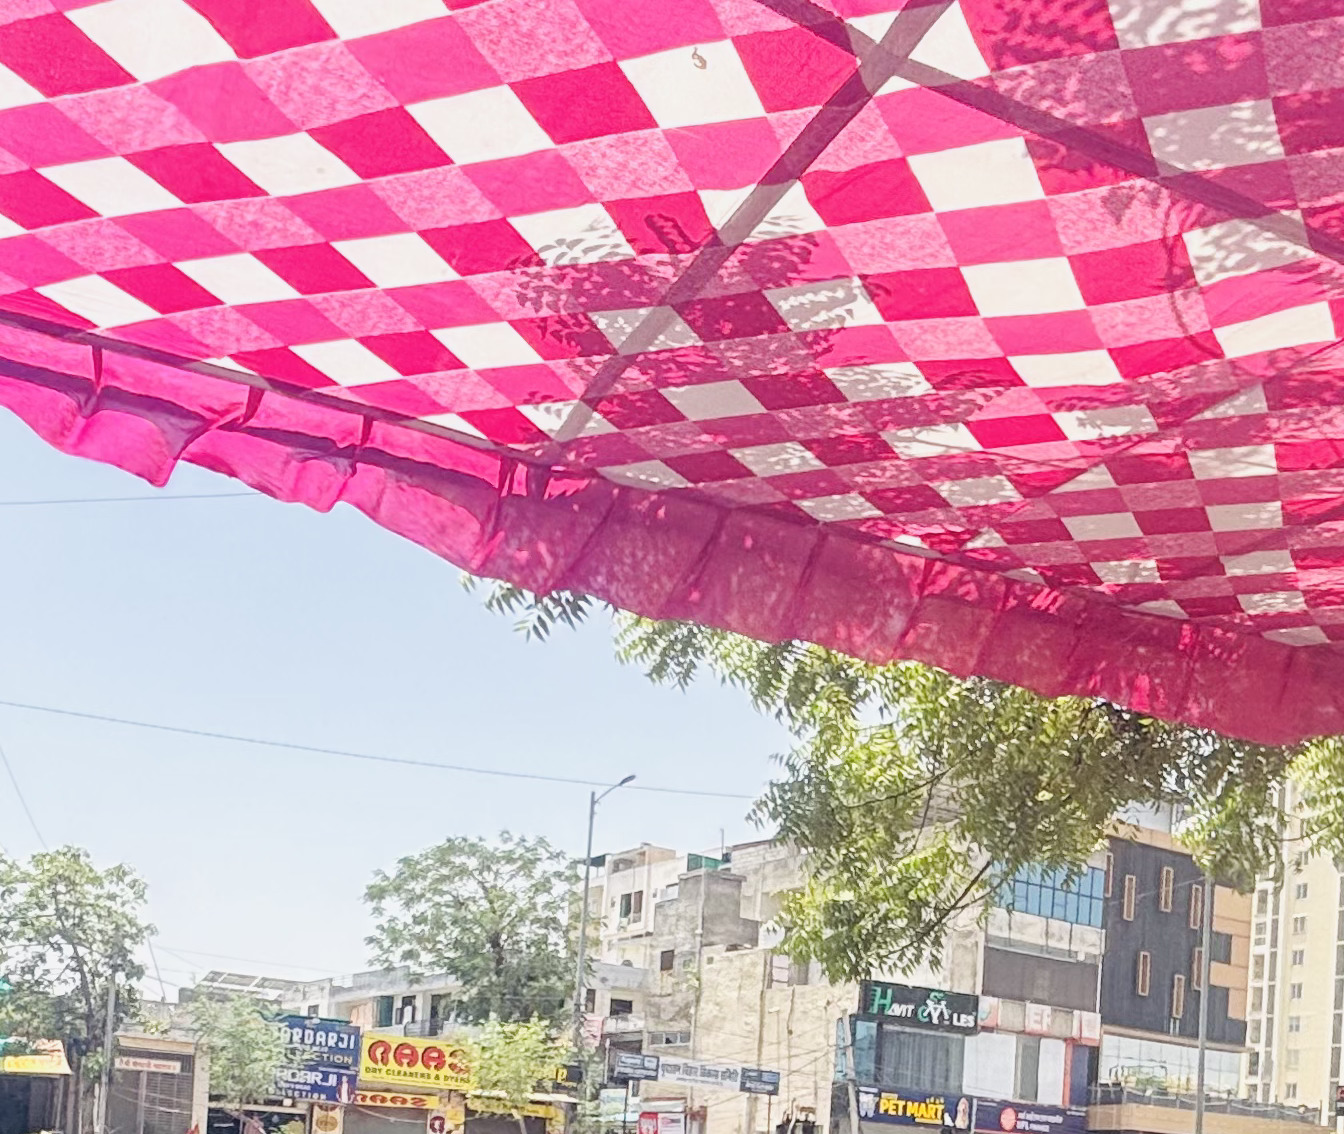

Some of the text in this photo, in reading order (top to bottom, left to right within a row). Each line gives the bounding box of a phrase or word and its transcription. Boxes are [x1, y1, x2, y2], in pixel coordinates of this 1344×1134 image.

[279, 1026, 356, 1050] ARDARJI
[273, 1067, 337, 1087] RDARJI
[364, 1066, 383, 1076] DRY
[385, 1069, 432, 1081] CLEANERS
[879, 1099, 905, 1117] PET
[906, 1100, 944, 1120] MART
